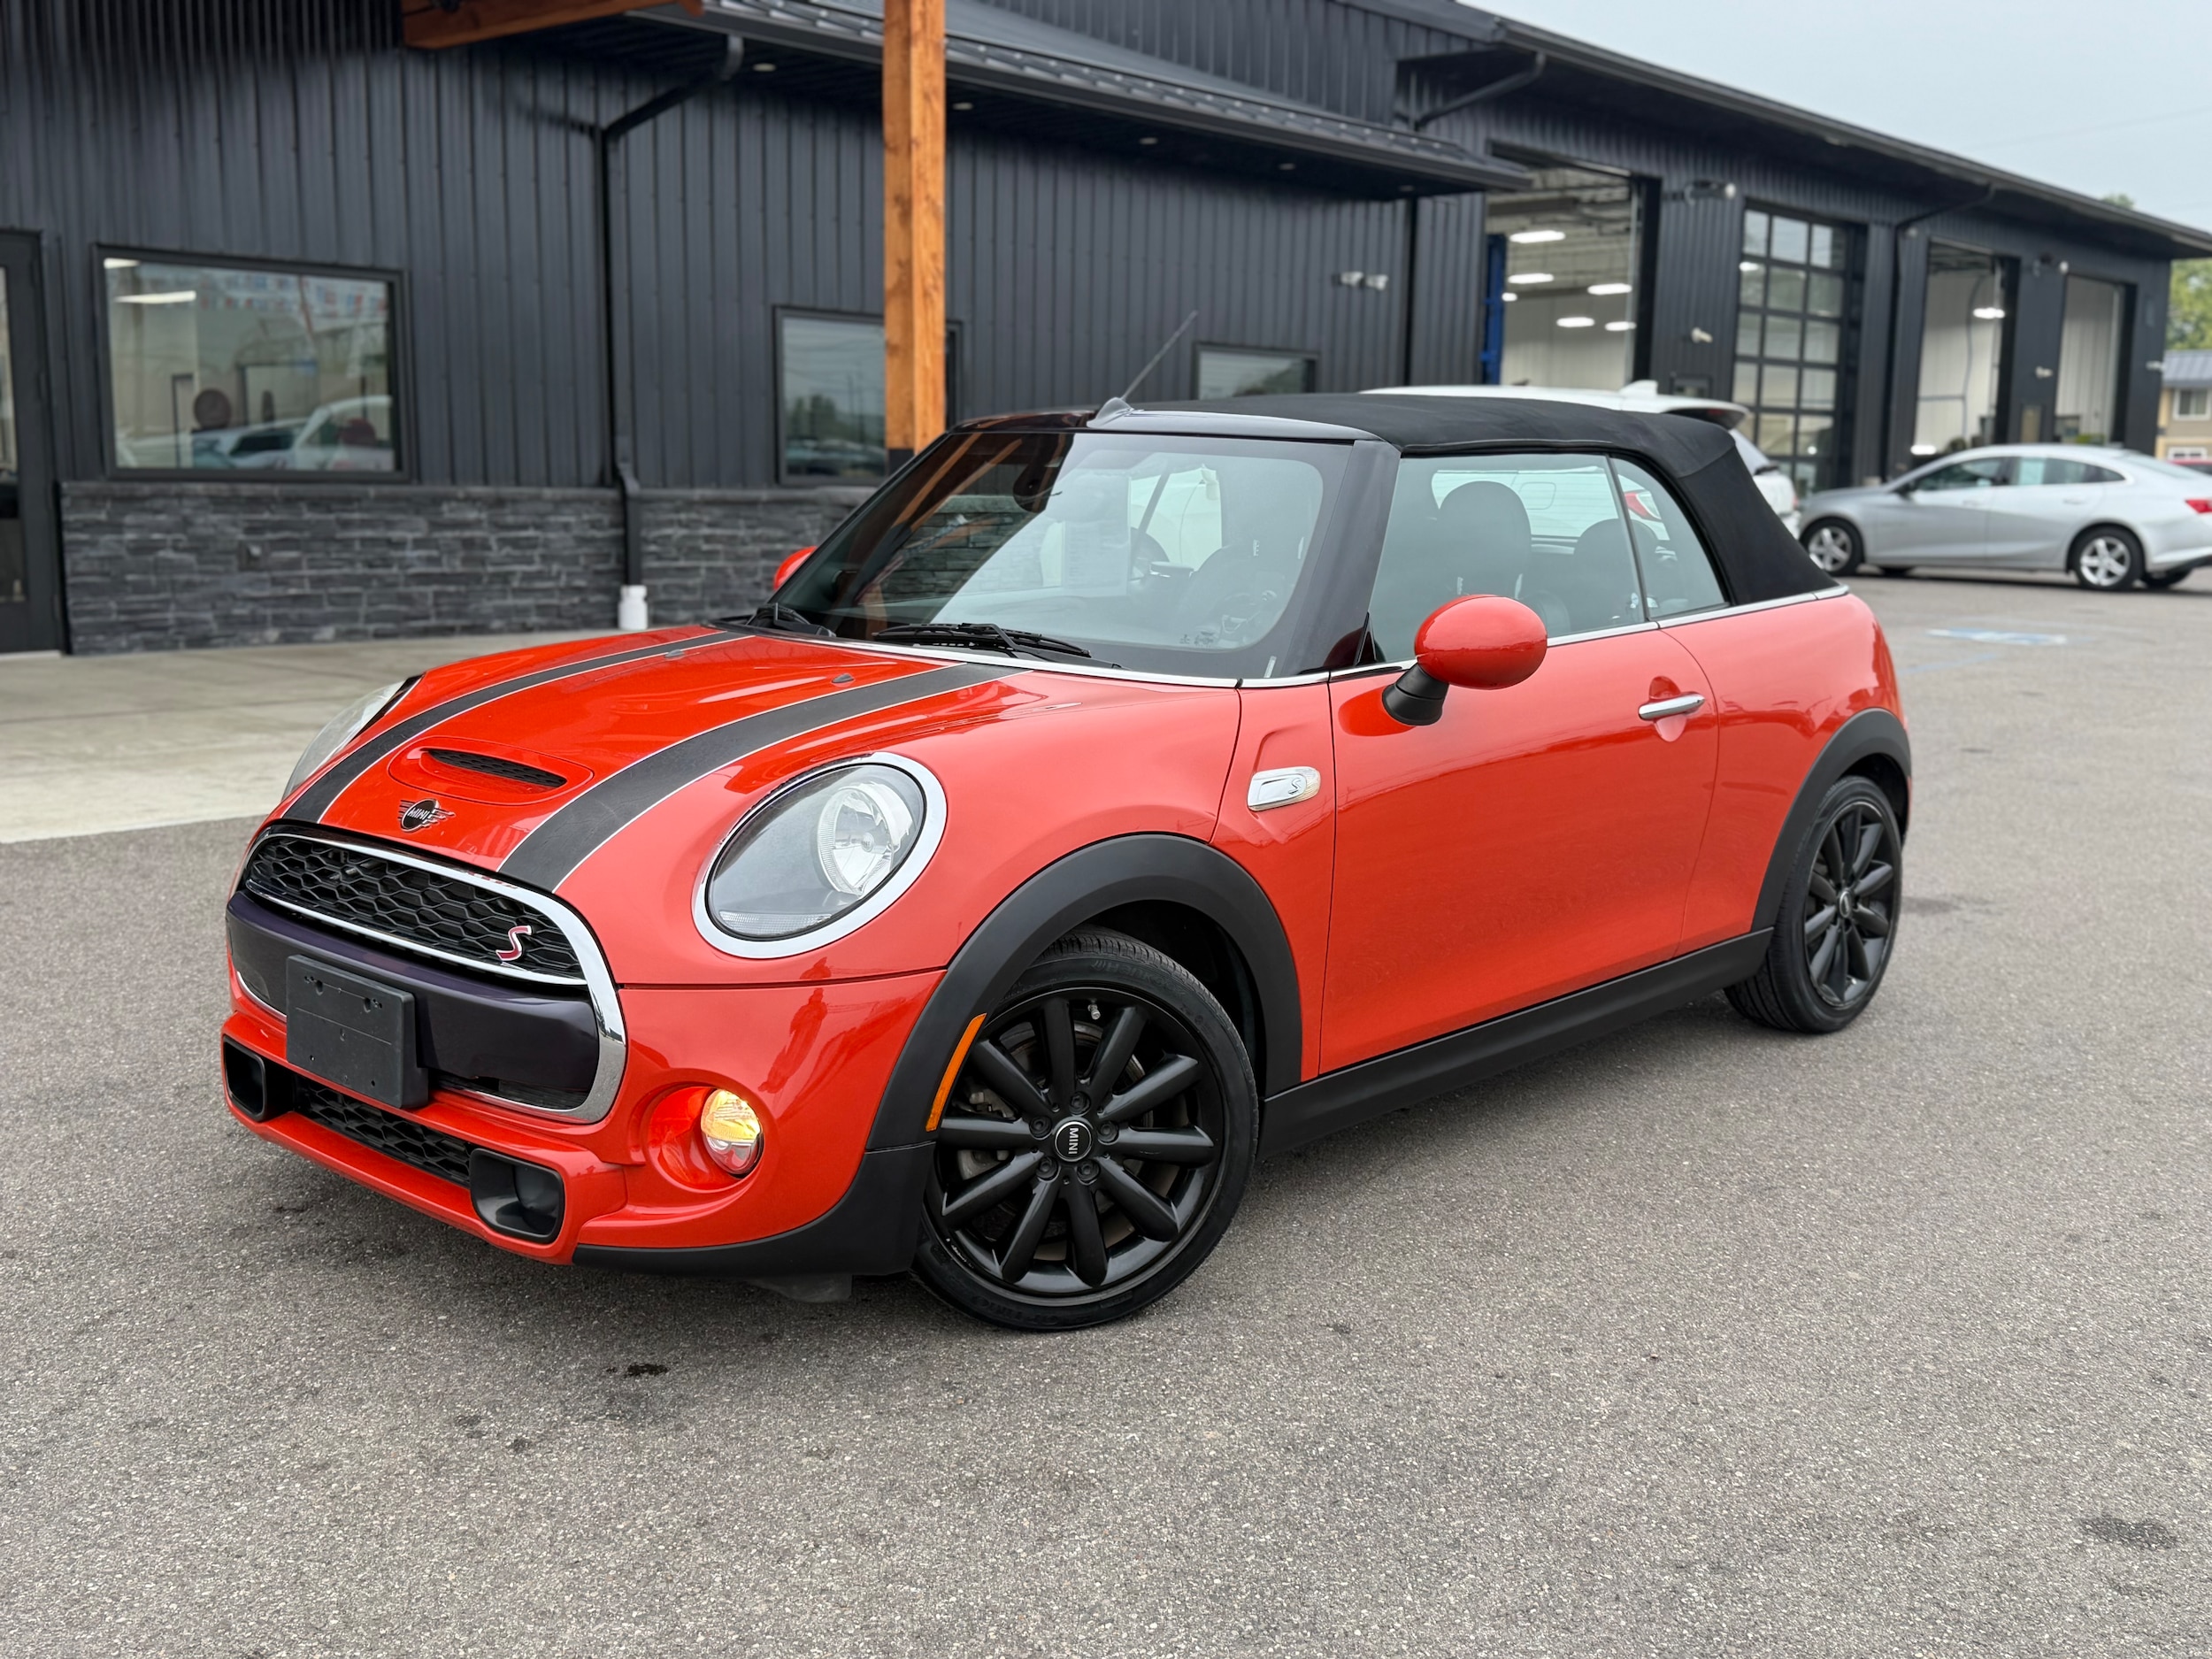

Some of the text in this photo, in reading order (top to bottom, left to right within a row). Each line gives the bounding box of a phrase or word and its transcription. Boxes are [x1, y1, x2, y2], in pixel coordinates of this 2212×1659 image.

[1288, 778, 1302, 795] S
[407, 807, 431, 820] MINI
[495, 925, 532, 961] S
[1068, 1127, 1079, 1155] MINI
